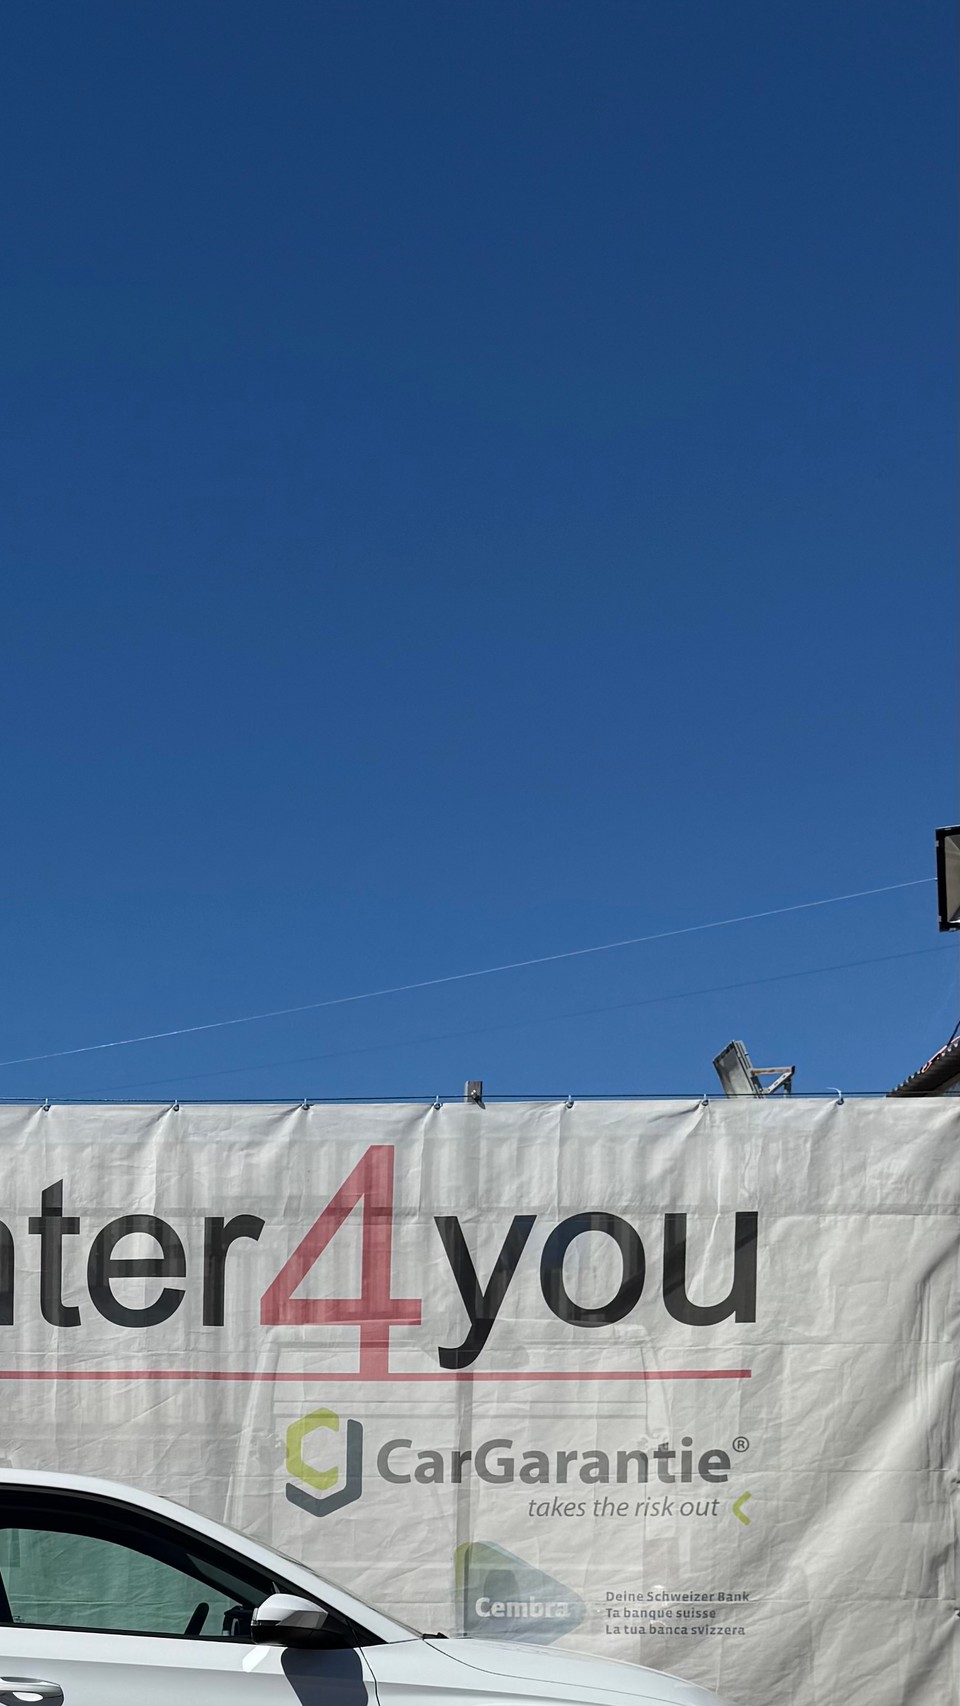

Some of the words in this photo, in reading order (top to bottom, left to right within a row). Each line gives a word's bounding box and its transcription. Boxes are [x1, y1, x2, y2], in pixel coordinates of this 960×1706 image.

[527, 1496, 586, 1517] takes
[592, 1496, 628, 1517] the
[634, 1496, 674, 1517] risk
[679, 1498, 720, 1517] out
[605, 1590, 643, 1603] Deine
[646, 1590, 715, 1603] Schweizer
[717, 1590, 750, 1603] Bank
[474, 1595, 572, 1619] Cembra
[605, 1607, 621, 1619] Ta
[623, 1607, 673, 1622] banque
[675, 1608, 717, 1619] suisse
[605, 1624, 622, 1636] La
[623, 1625, 646, 1636] tua
[648, 1624, 689, 1636] banca
[690, 1624, 746, 1636] svizzera
